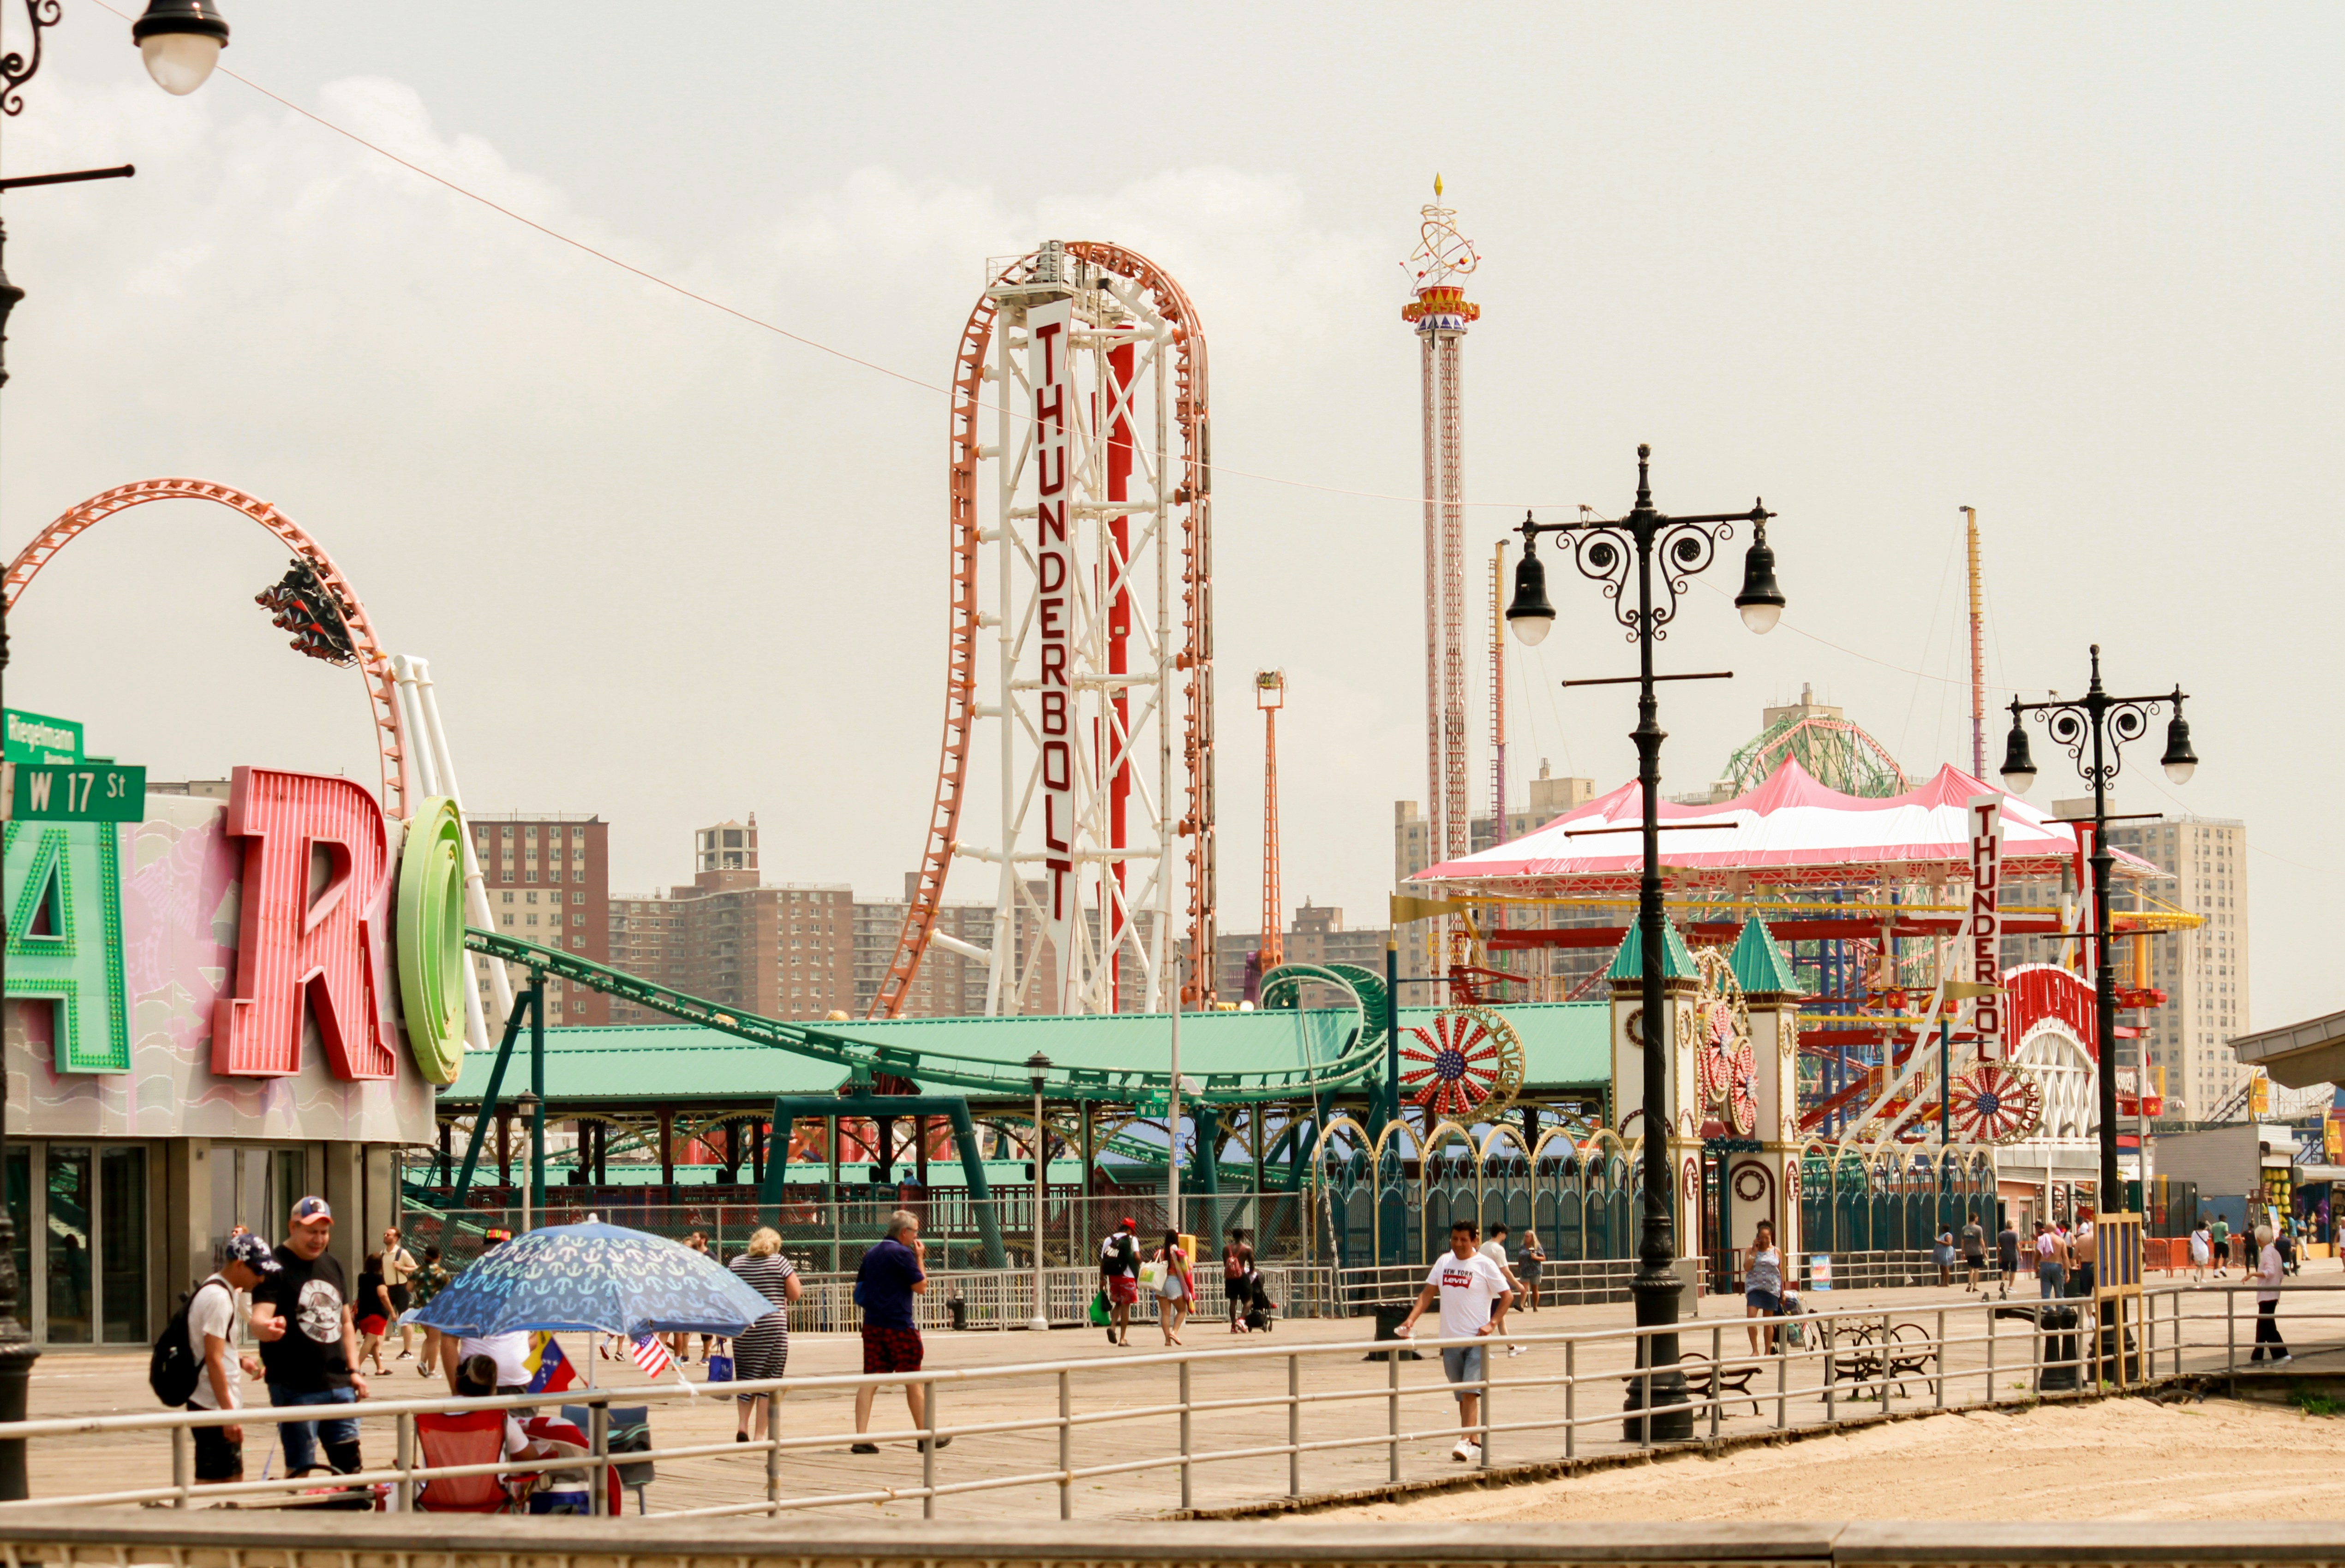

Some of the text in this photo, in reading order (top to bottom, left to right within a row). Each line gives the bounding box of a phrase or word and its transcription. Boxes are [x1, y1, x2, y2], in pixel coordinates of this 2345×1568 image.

[1035, 322, 1072, 921] THUNDERBOLT
[30, 771, 126, 813] W 17 St
[1973, 804, 1998, 1061] THUNDERBOL
[1140, 1105, 1146, 1115] W
[1149, 1105, 1157, 1116] 16
